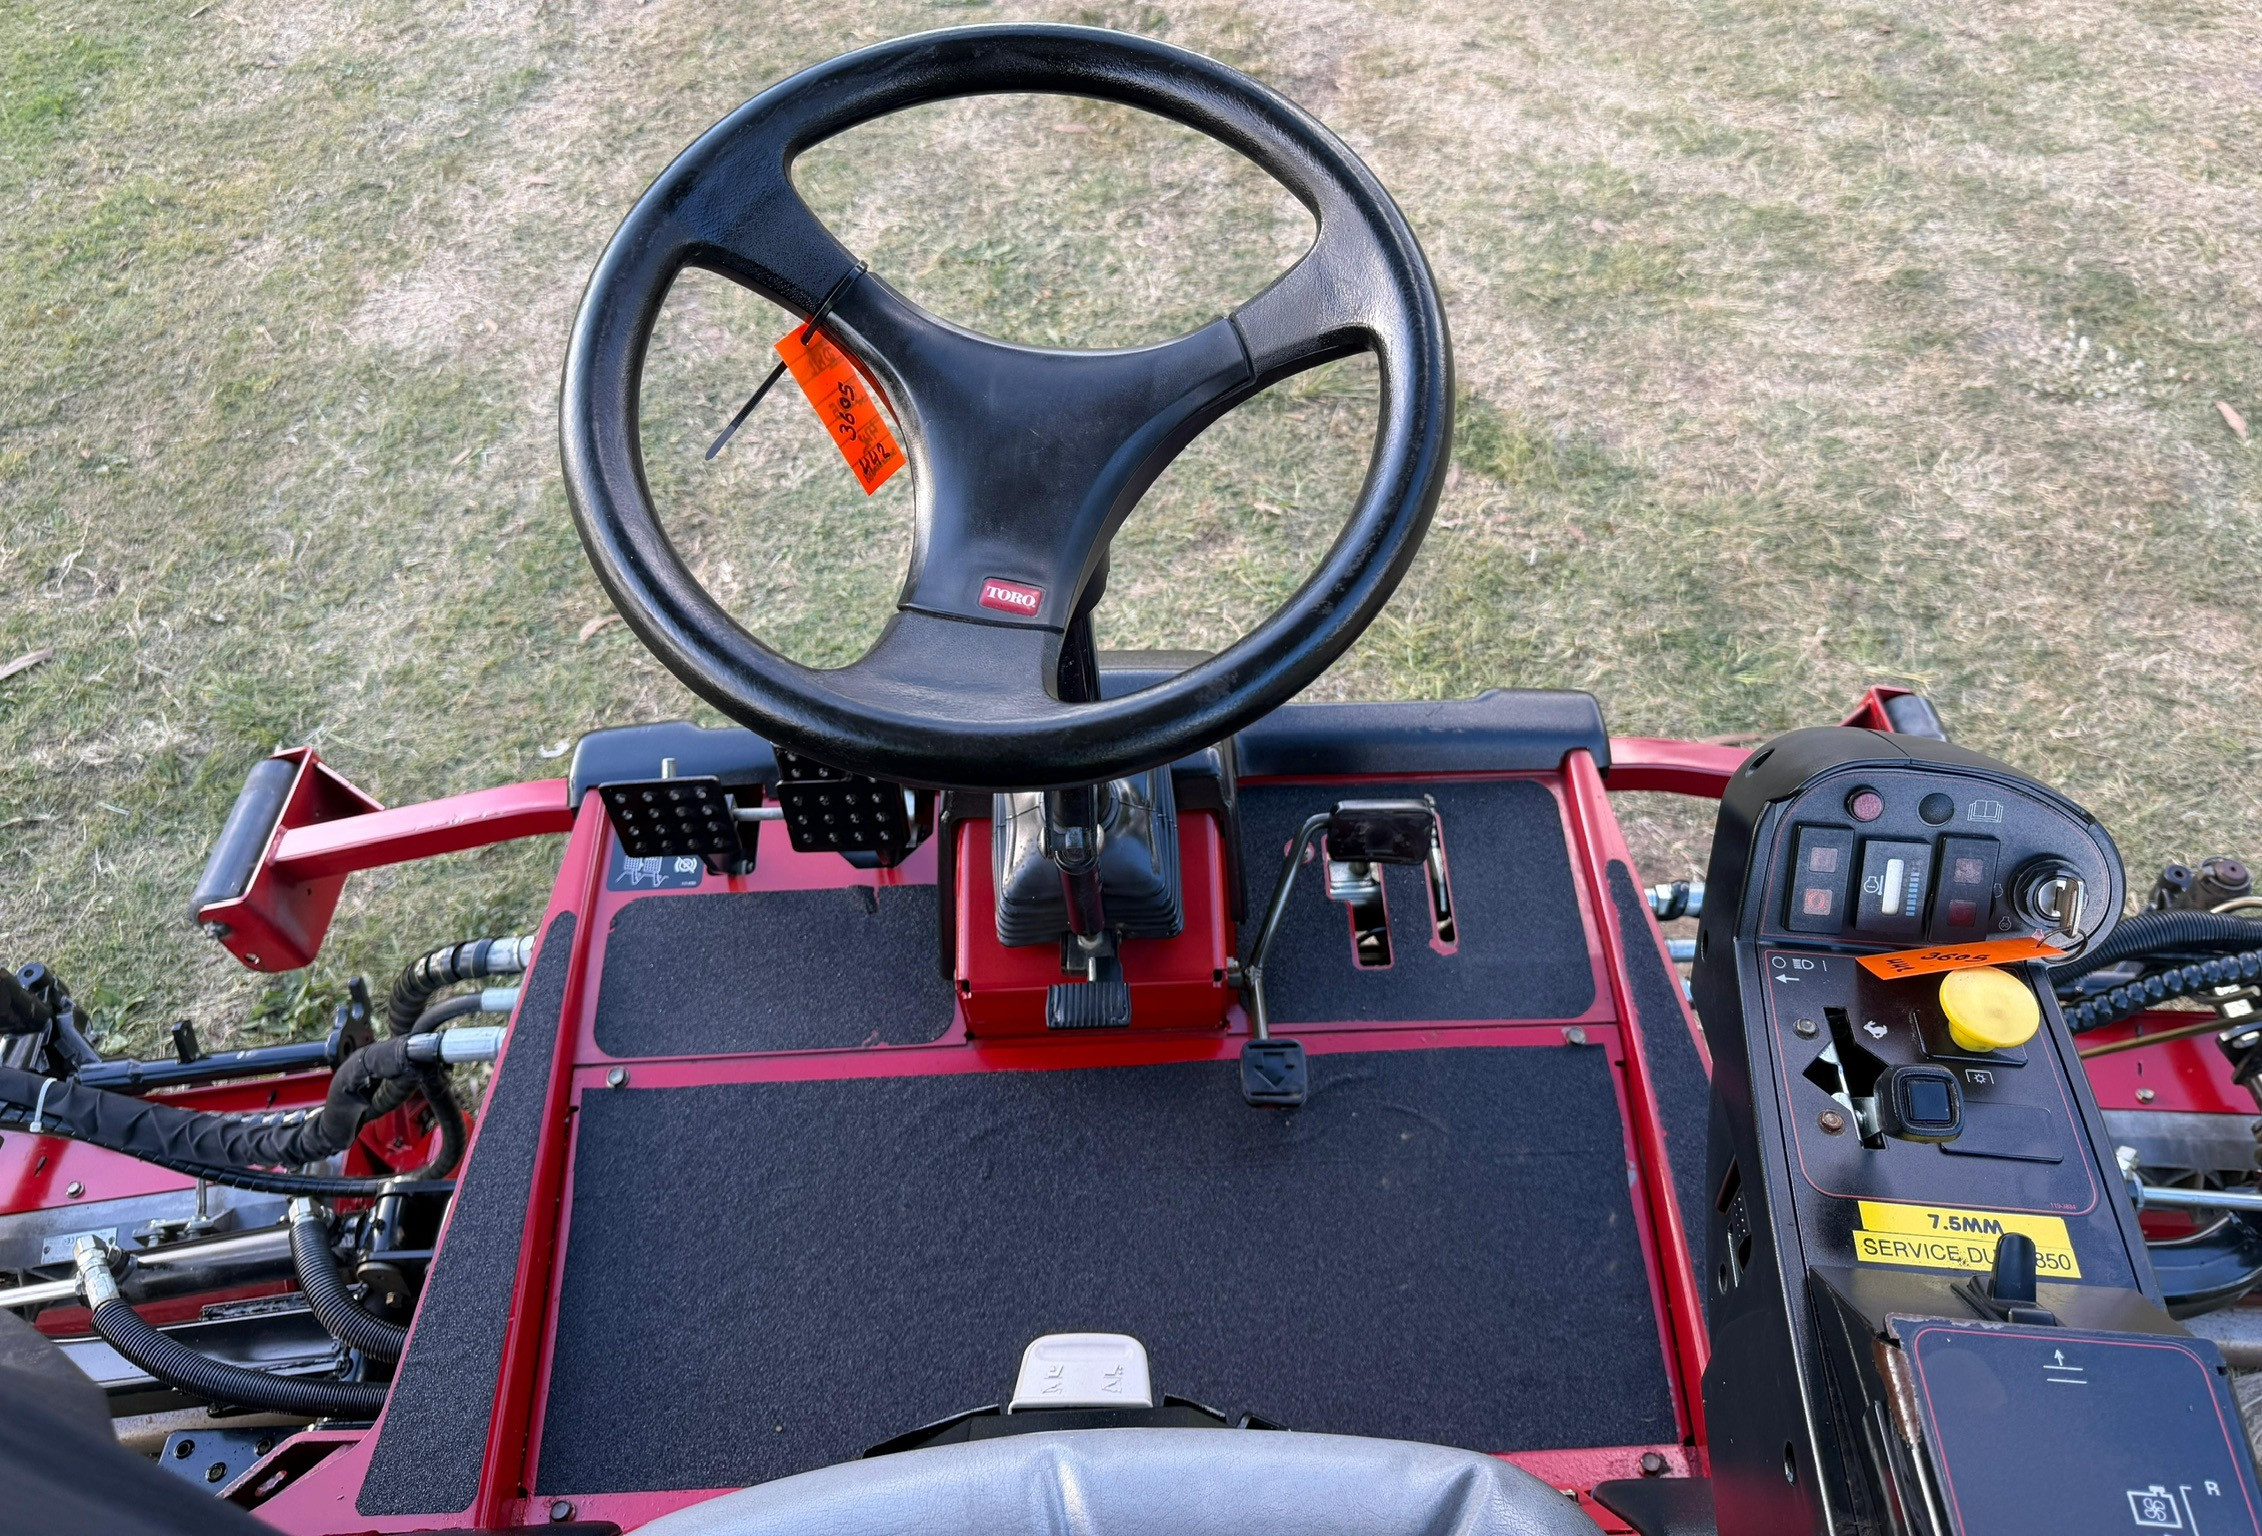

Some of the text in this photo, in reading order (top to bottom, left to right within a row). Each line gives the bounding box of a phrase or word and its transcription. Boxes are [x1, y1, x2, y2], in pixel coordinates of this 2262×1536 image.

[986, 585, 1036, 608] TORO
[1927, 1213, 2004, 1235] 7.5MM
[1863, 1237, 1962, 1263] SERVICE
[1967, 1246, 1996, 1265] DU
[2204, 1480, 2221, 1496] R
